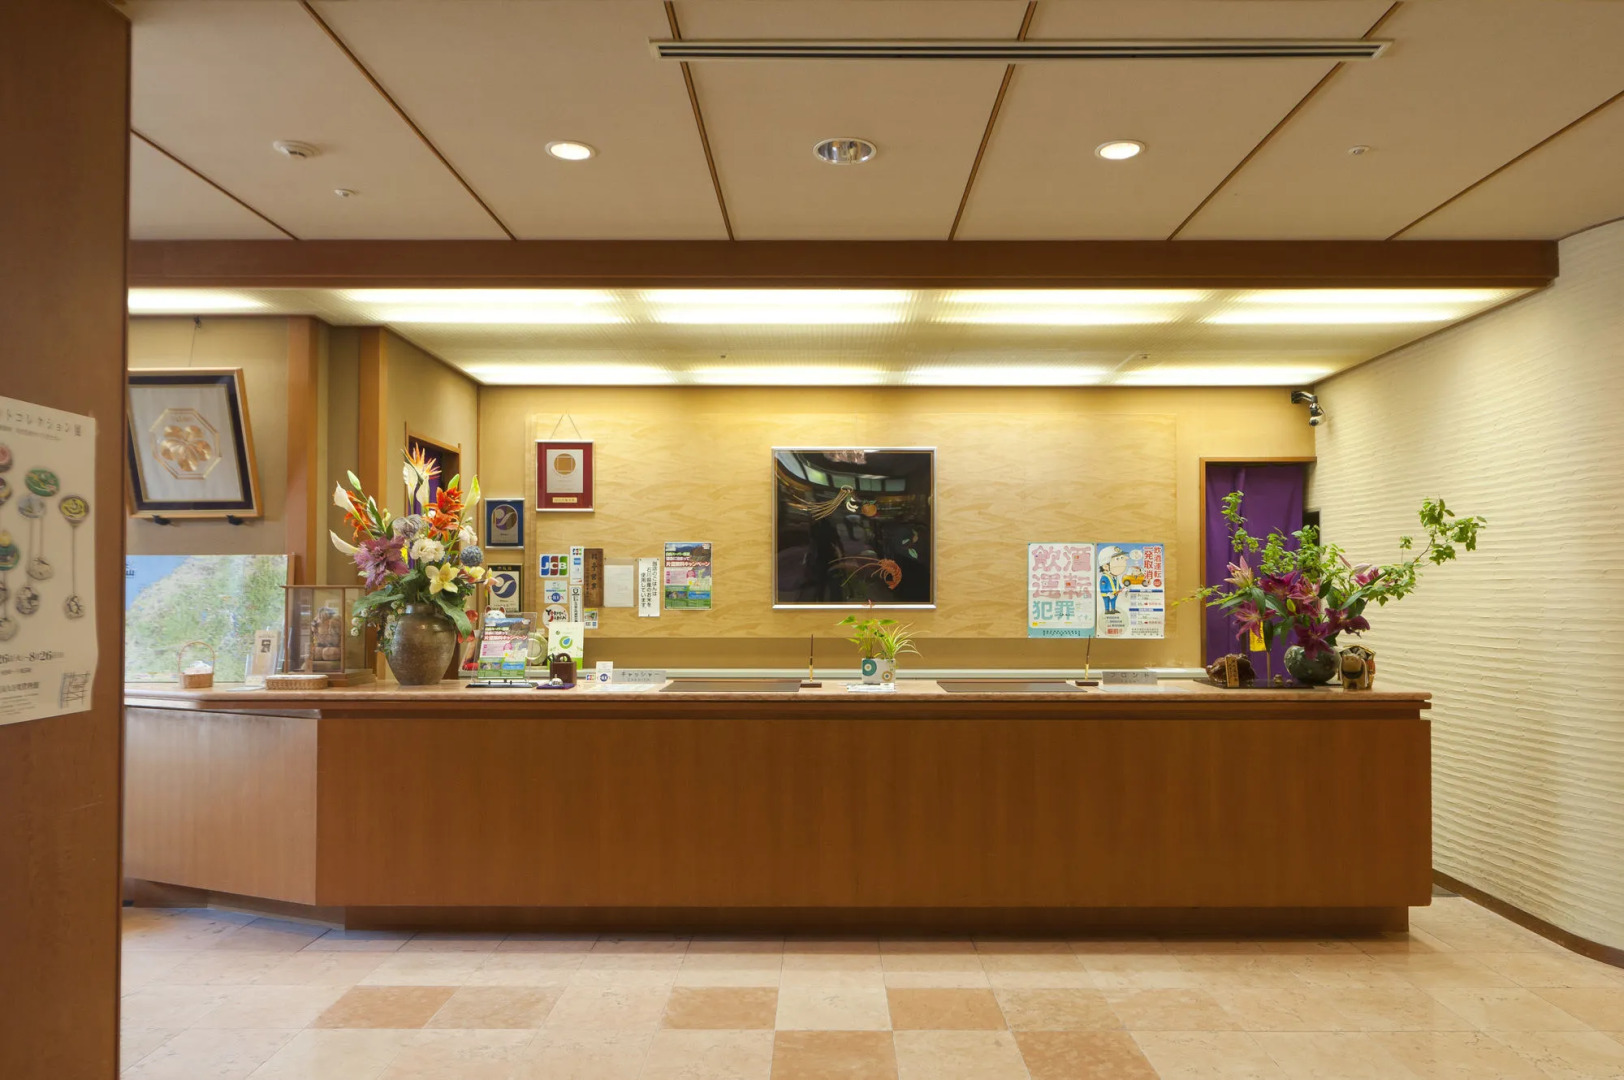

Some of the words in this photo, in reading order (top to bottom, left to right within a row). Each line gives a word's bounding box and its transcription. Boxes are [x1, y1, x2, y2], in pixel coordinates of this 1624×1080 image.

[1032, 545, 1092, 572] 飲酒
[1032, 573, 1092, 599] 運転
[1032, 600, 1075, 620] 犯罪
[1110, 671, 1150, 679] フロント
